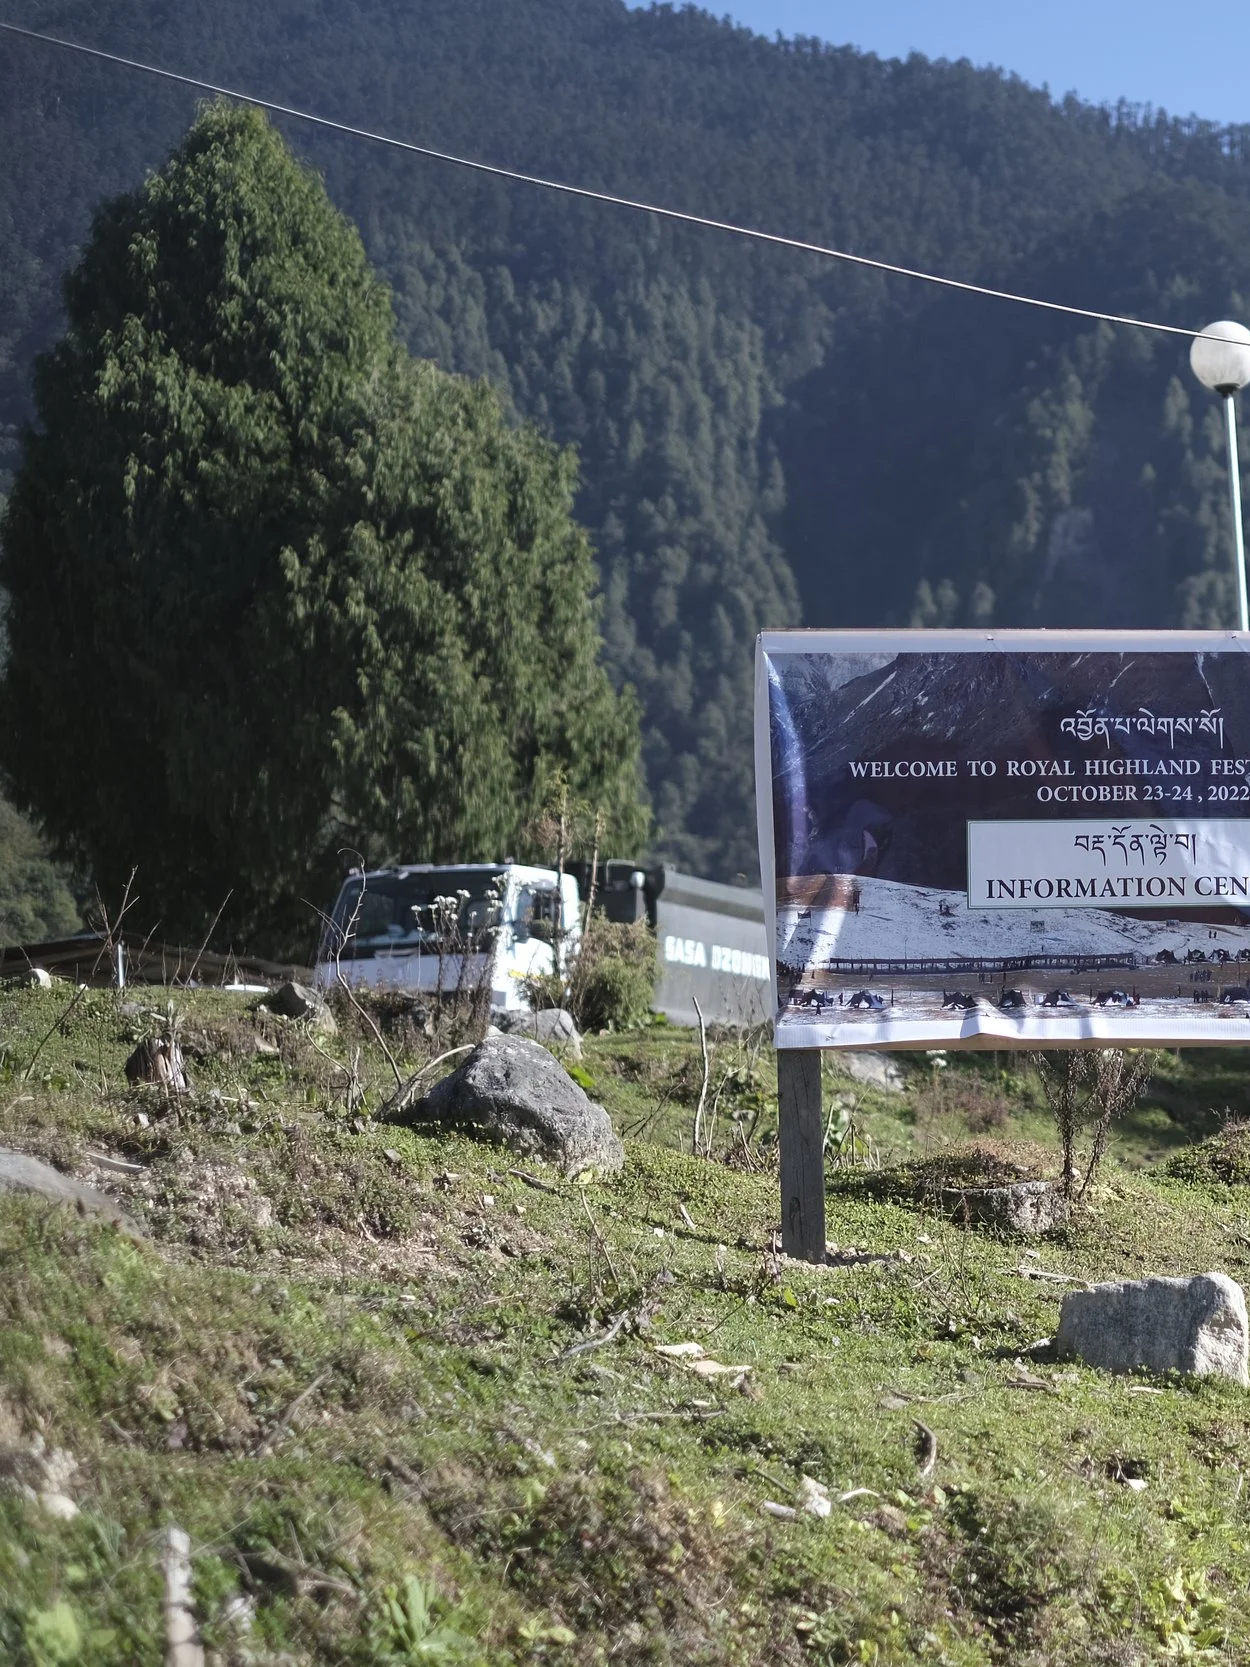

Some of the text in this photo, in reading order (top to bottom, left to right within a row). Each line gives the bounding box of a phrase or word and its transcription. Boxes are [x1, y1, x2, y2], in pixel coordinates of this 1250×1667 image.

[849, 762, 957, 777] WELCOME
[967, 761, 996, 776] TO
[1007, 761, 1075, 775] ROYAL
[1085, 760, 1200, 775] HIGHLAND
[1037, 786, 1138, 801] OCTOBER
[1208, 786, 1250, 800] 2022
[986, 877, 1186, 898] INFORMATION
